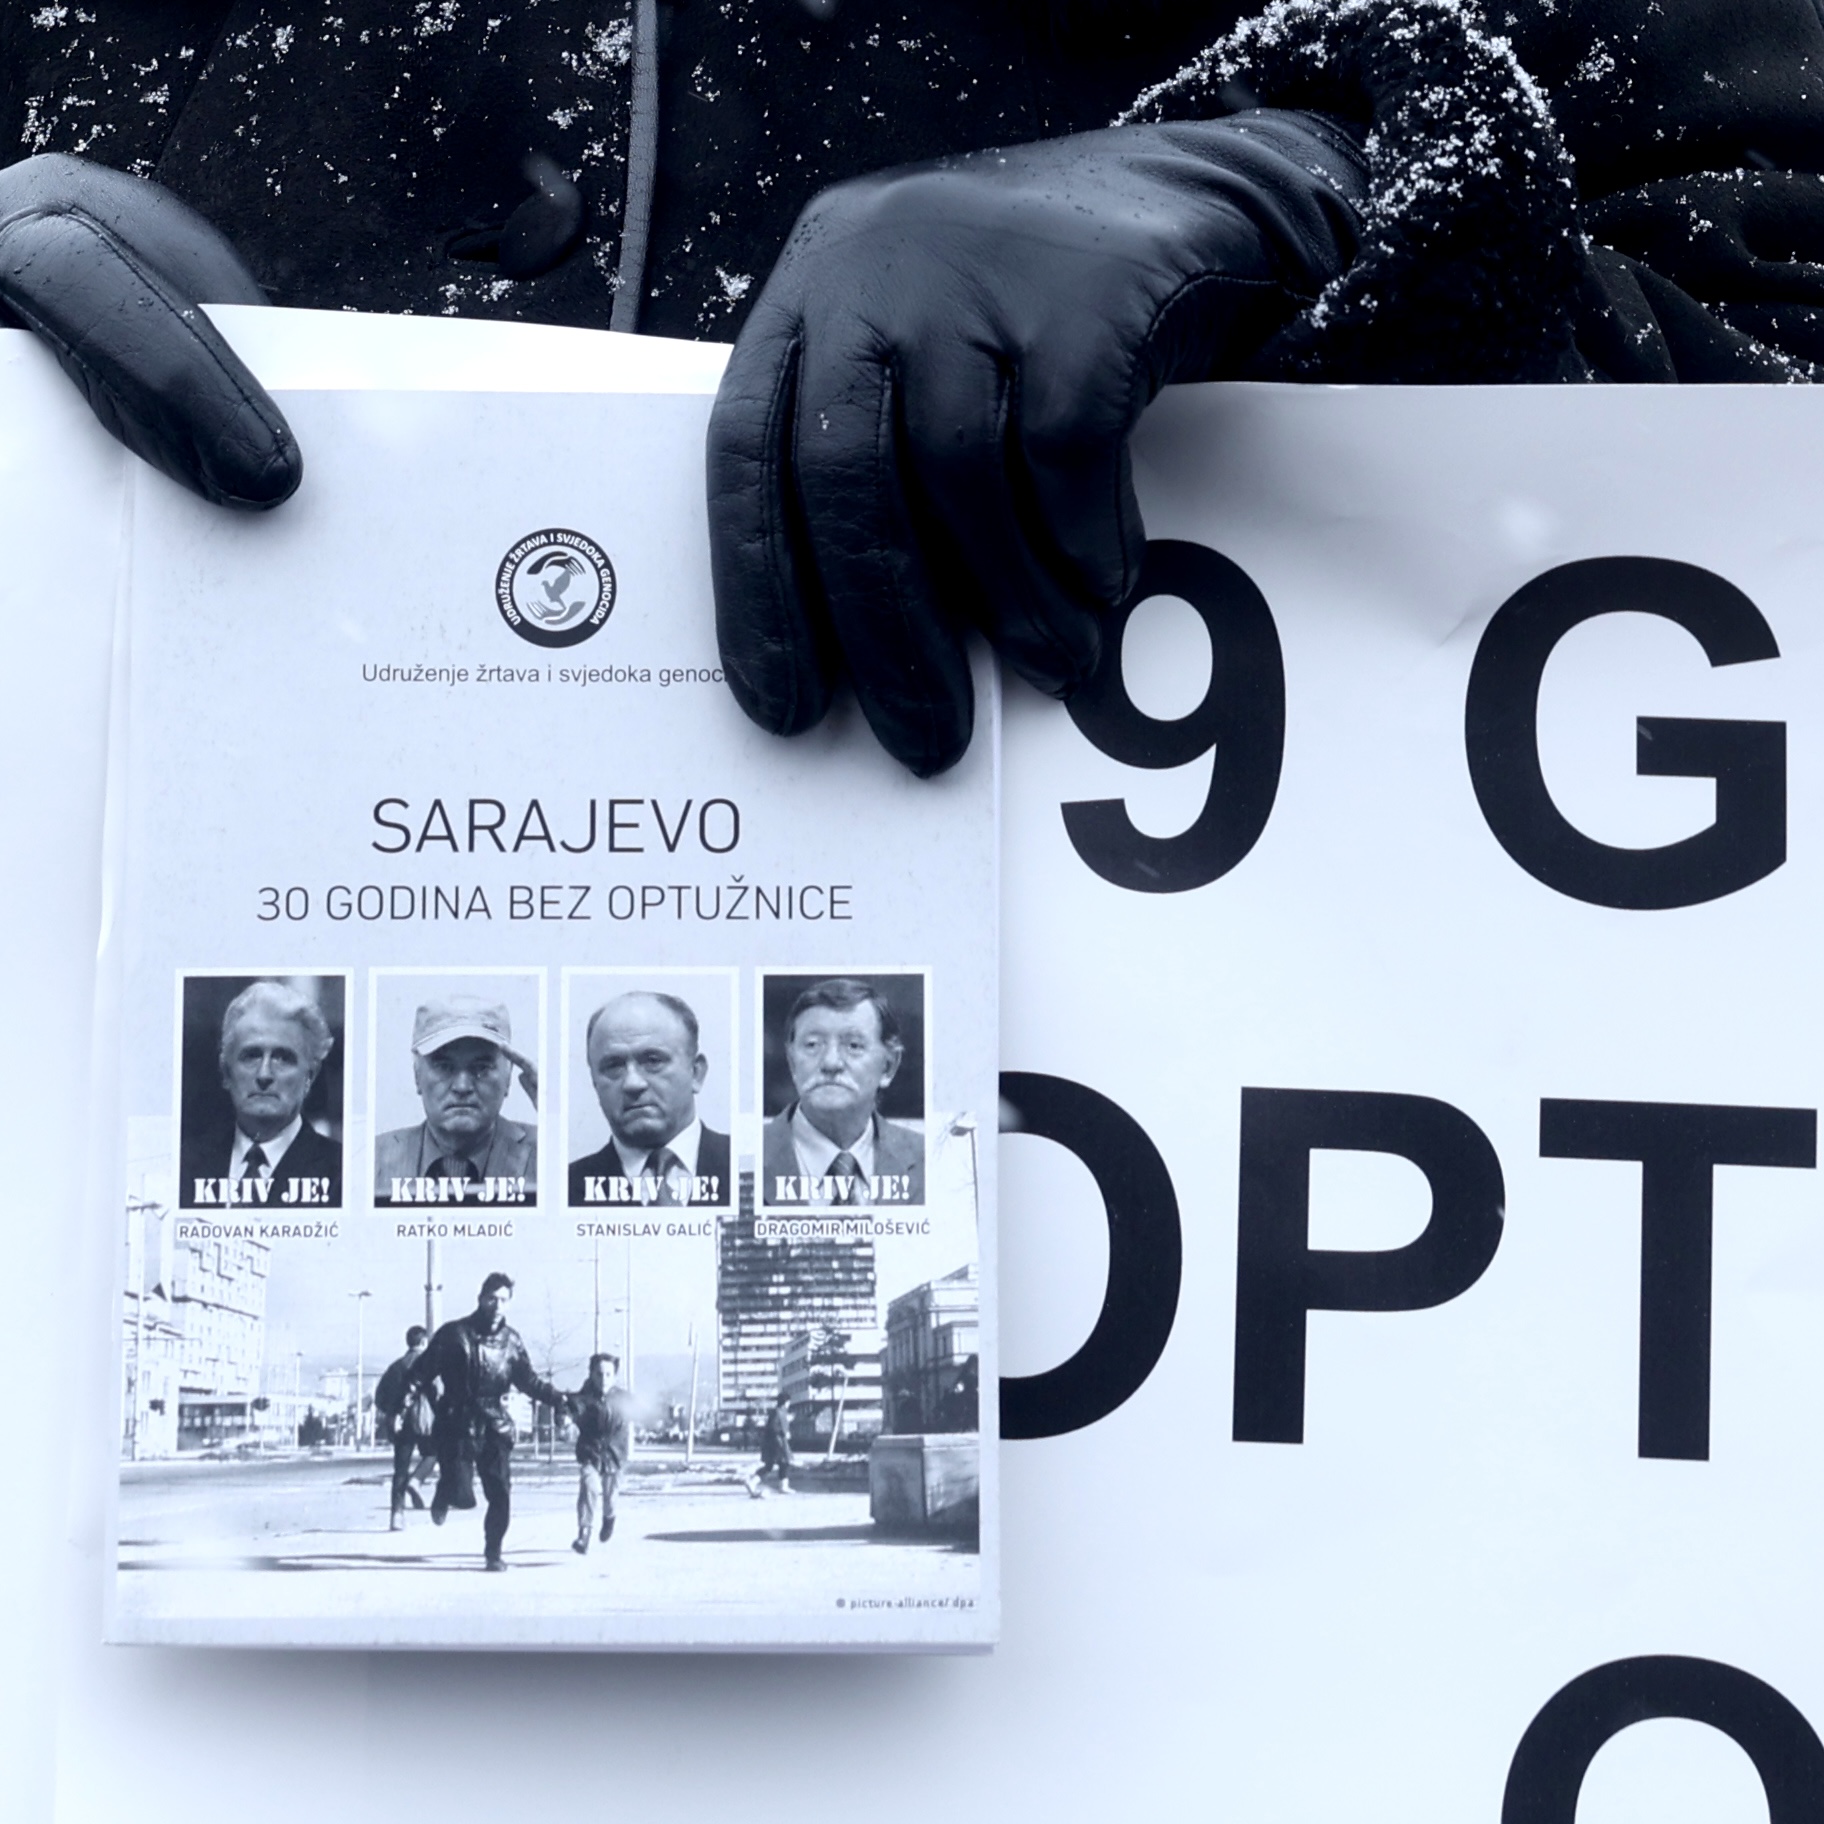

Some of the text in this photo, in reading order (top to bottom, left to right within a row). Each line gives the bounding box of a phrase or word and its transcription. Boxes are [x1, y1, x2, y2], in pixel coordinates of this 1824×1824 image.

[498, 533, 613, 626] UDRUŽENJE ŽRTAVA I SVJEDOKA GENOCIDA
[362, 663, 728, 688] Udruženje žrtava i svjedoka genoc
[371, 797, 742, 855] SARAJEVO
[256, 874, 853, 922] 30 GODINA BEZ OPTUŽNICE
[193, 1178, 330, 1204] KRIV JE!
[389, 1176, 526, 1203] KRIV JE!
[583, 1176, 720, 1202] KRIV JE!
[775, 1175, 911, 1202] KRIV JE!
[179, 1221, 339, 1239] RADOVAN KARADŽIĆ
[396, 1220, 513, 1238] RATKO MLADIĆ
[576, 1220, 712, 1237] STANISLAV GALIĆ
[756, 1218, 931, 1236] DRAGOMIR MILOŠEVIĆ
